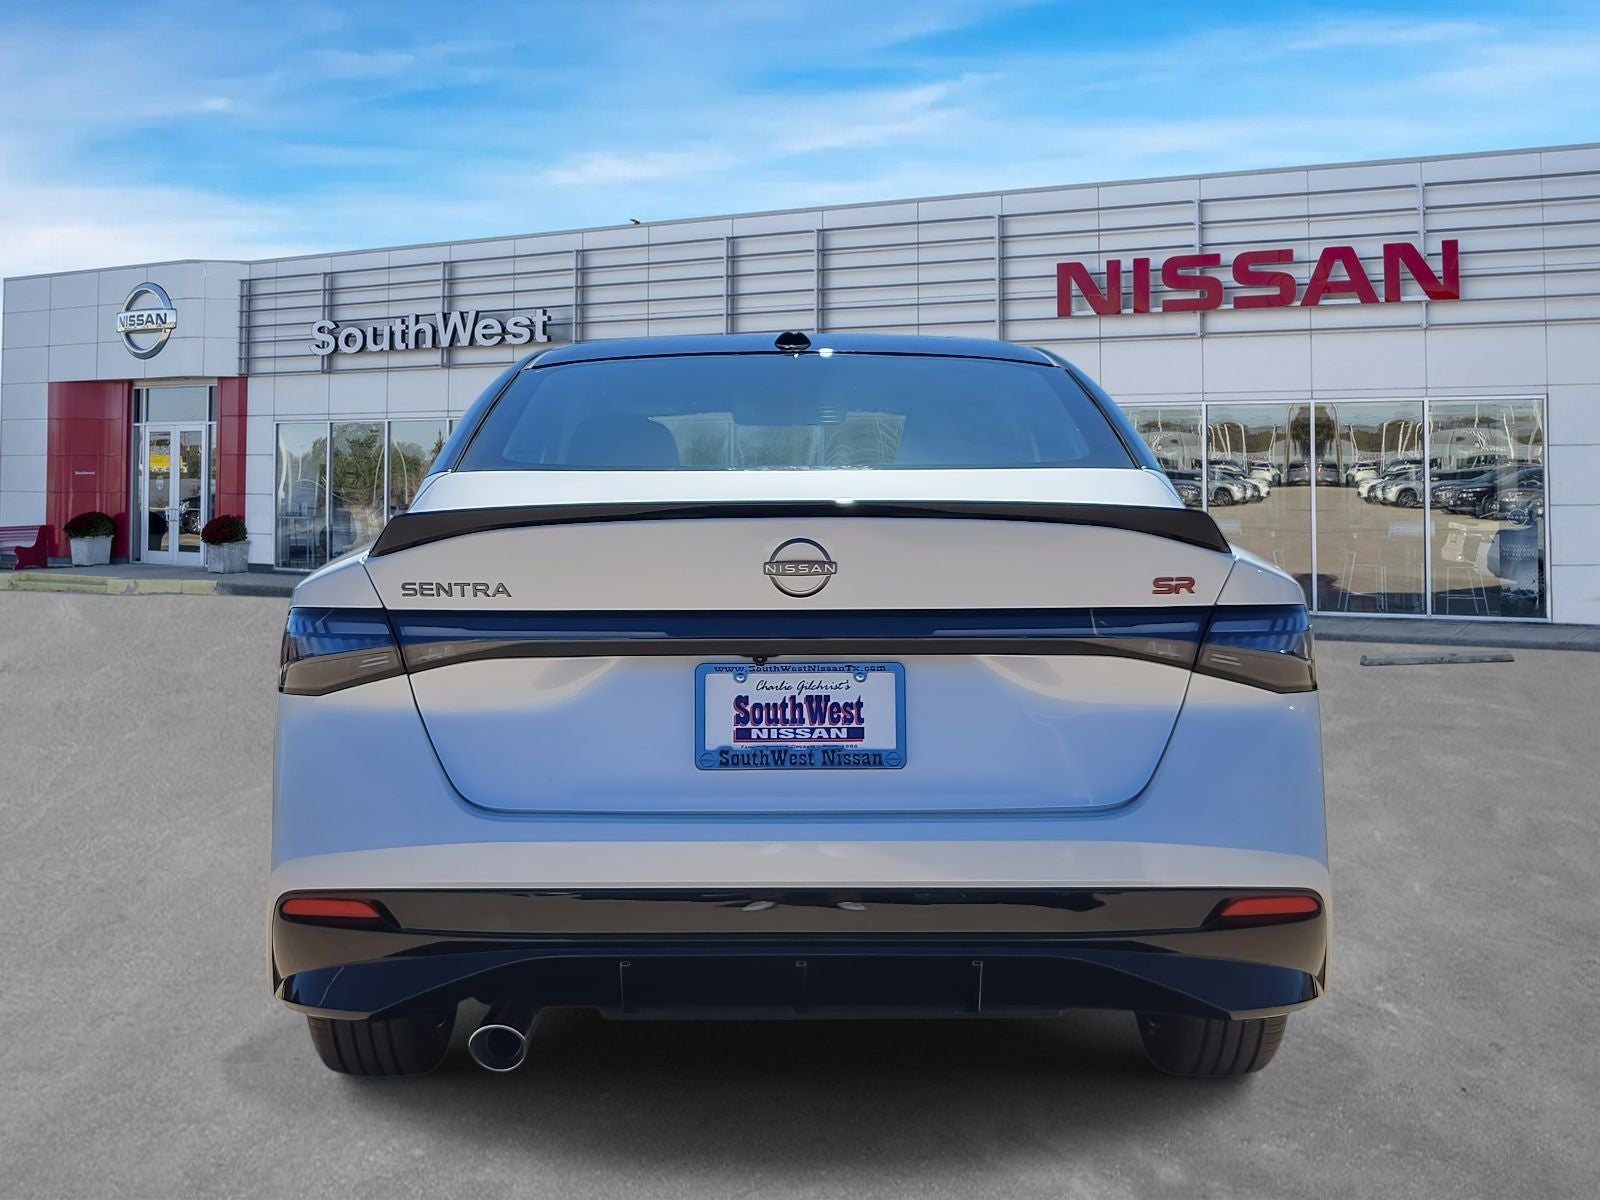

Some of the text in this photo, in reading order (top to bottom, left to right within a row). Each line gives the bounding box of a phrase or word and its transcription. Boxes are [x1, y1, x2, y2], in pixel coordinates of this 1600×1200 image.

[1057, 239, 1460, 317] NISSAN
[119, 313, 167, 327] NISSAN
[308, 308, 552, 355] SouthWest
[765, 564, 836, 573] NISSAN
[401, 582, 512, 597] SENTRA
[1152, 576, 1195, 594] SR
[755, 679, 851, 696] Charlie Gilchrist's
[733, 695, 865, 727] SouthWest
[751, 728, 848, 739] NISSAN
[719, 750, 883, 767] SouthWest Nissan
